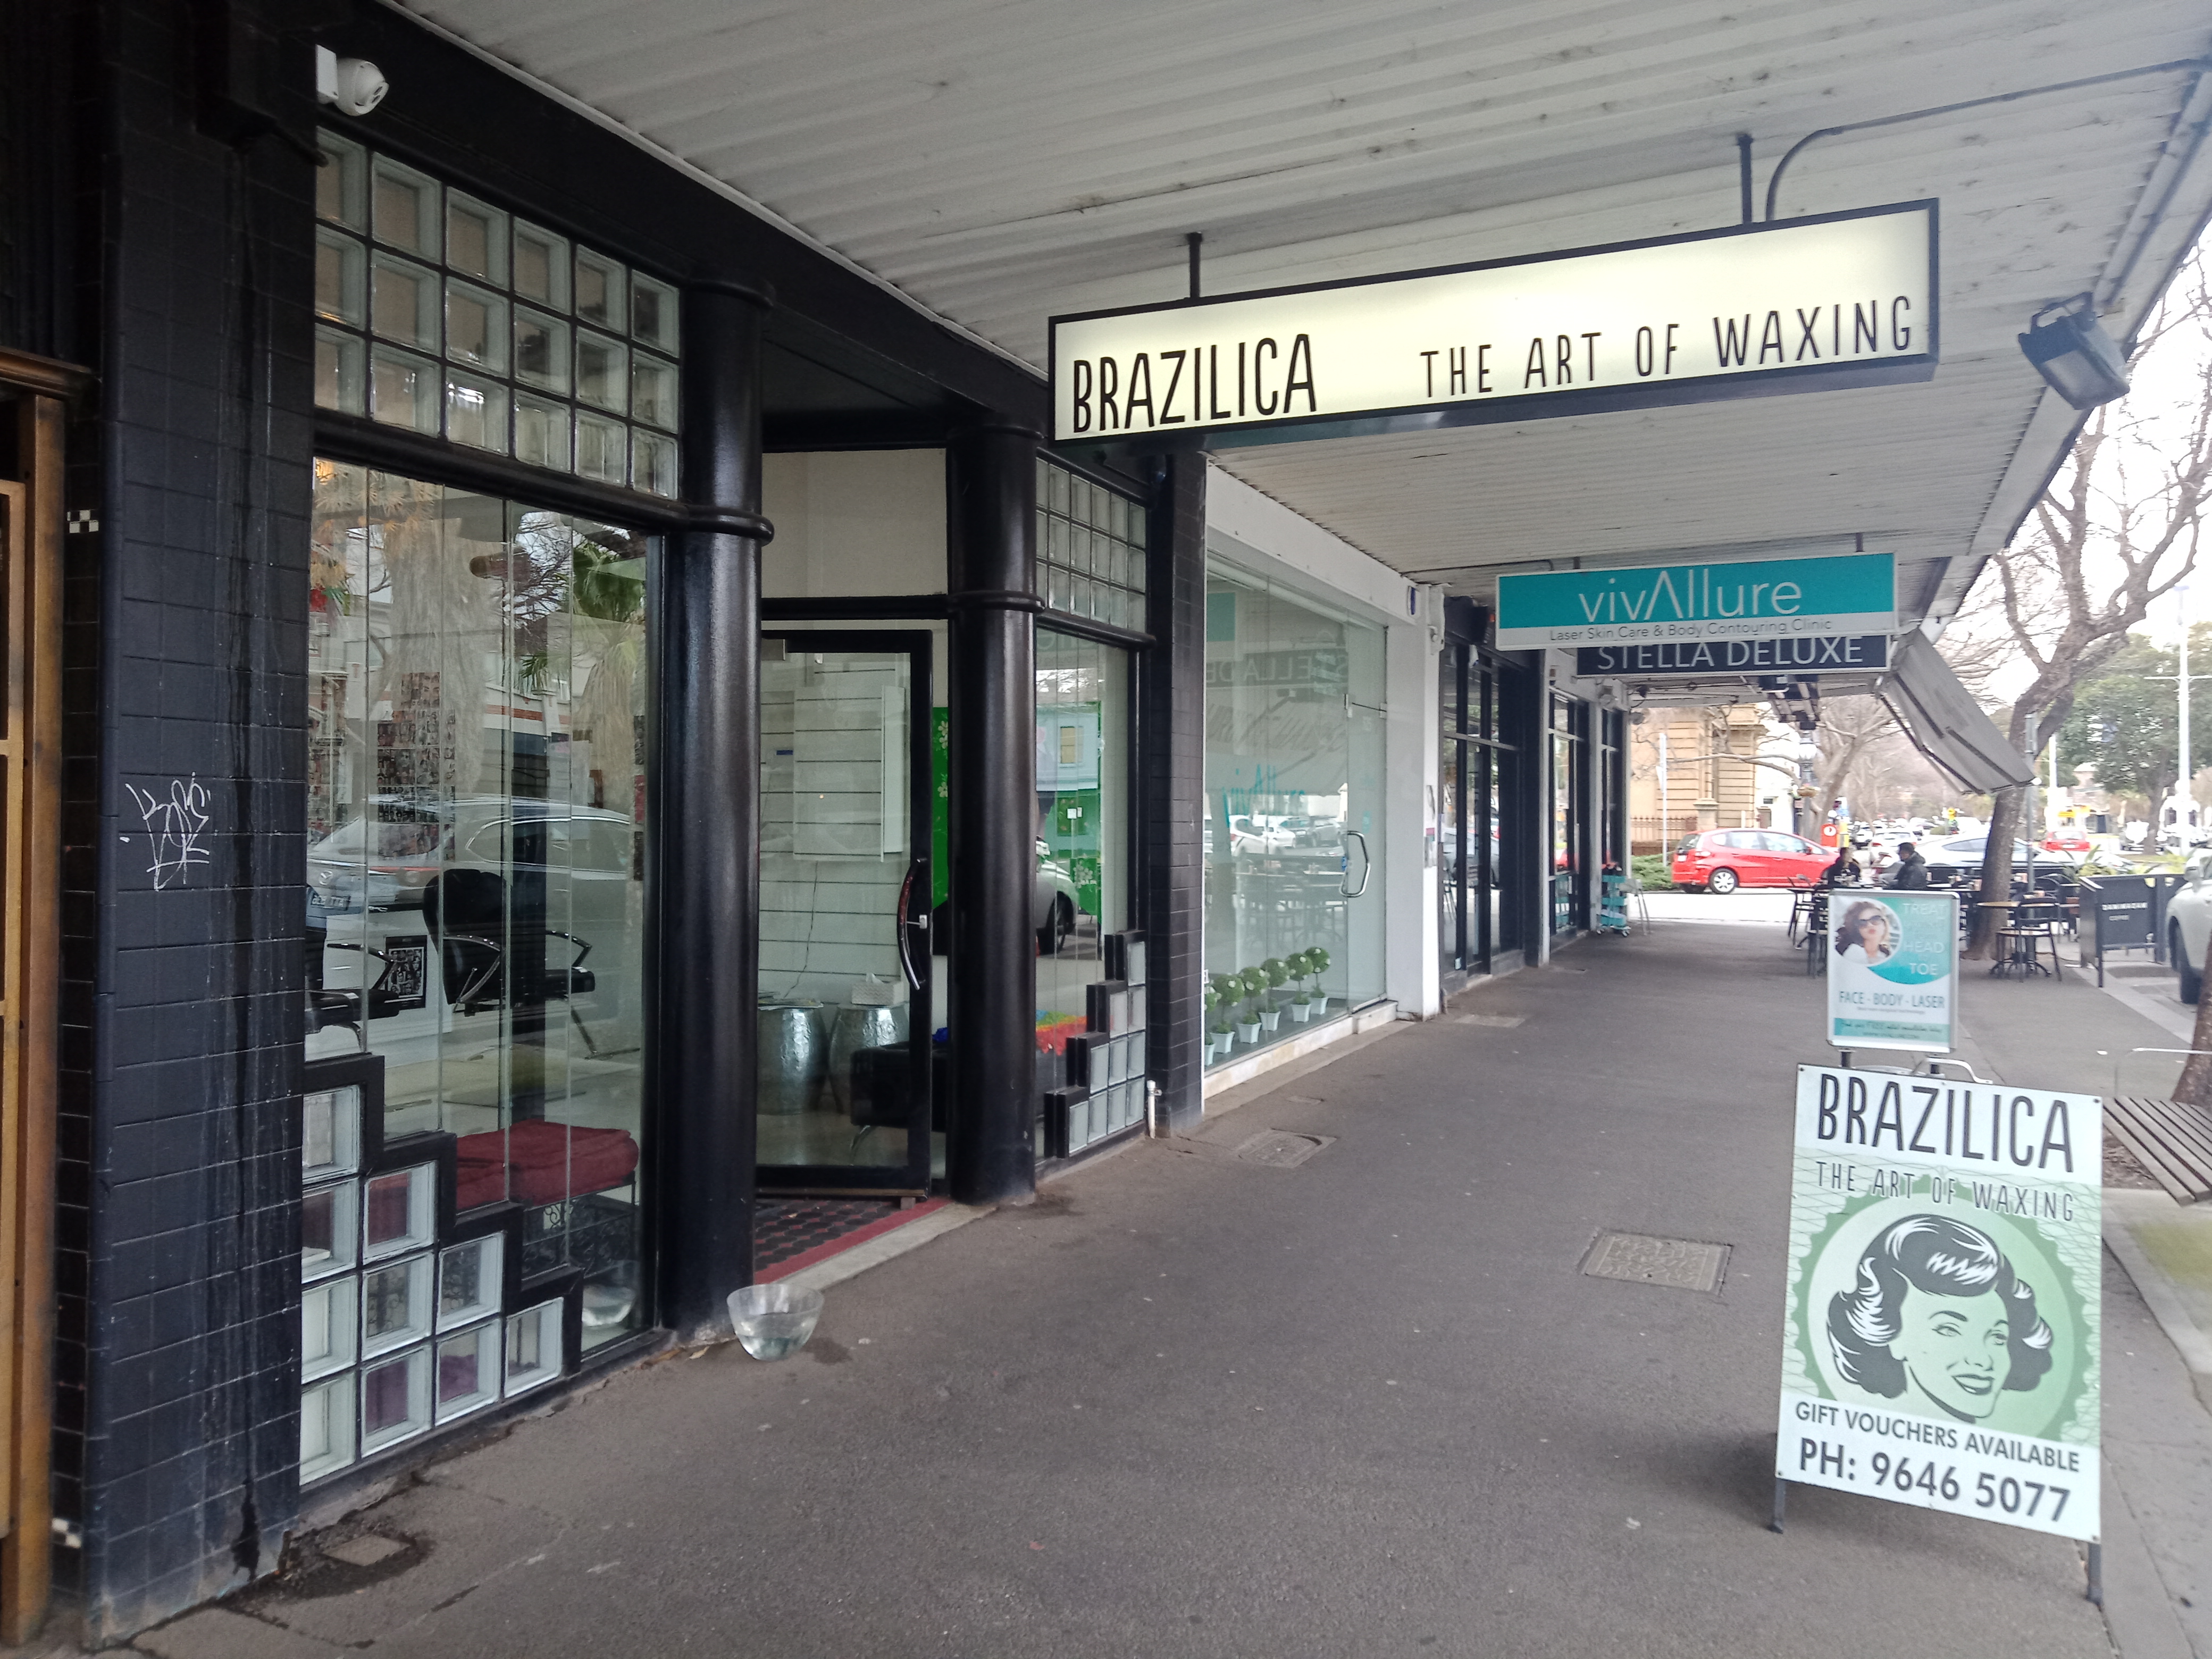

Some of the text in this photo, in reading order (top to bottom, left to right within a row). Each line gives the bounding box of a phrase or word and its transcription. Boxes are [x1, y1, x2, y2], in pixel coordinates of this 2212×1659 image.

[1073, 296, 1911, 433] BRAZILICA THE ART OF WAXING
[1578, 568, 1802, 622] vivAllure
[1549, 618, 1832, 641] Laser Skin Care & Body Contouring Clinic
[1727, 636, 1863, 666] DELUXE
[1903, 903, 1947, 915] TREAT
[1903, 941, 1945, 953] HEAD
[1909, 963, 1939, 975] TOE
[1839, 991, 1864, 1004] FACE
[1873, 993, 1903, 1006] BODY
[1912, 995, 1945, 1009] LASER
[1817, 1073, 2074, 1172] BRAZILICA
[1815, 1161, 2074, 1222] THE ART OF WAXING
[1796, 1401, 2080, 1472] GIFT VOUCHERS AVAILABLE
[1799, 1437, 2071, 1522] PH: 9646 5077
